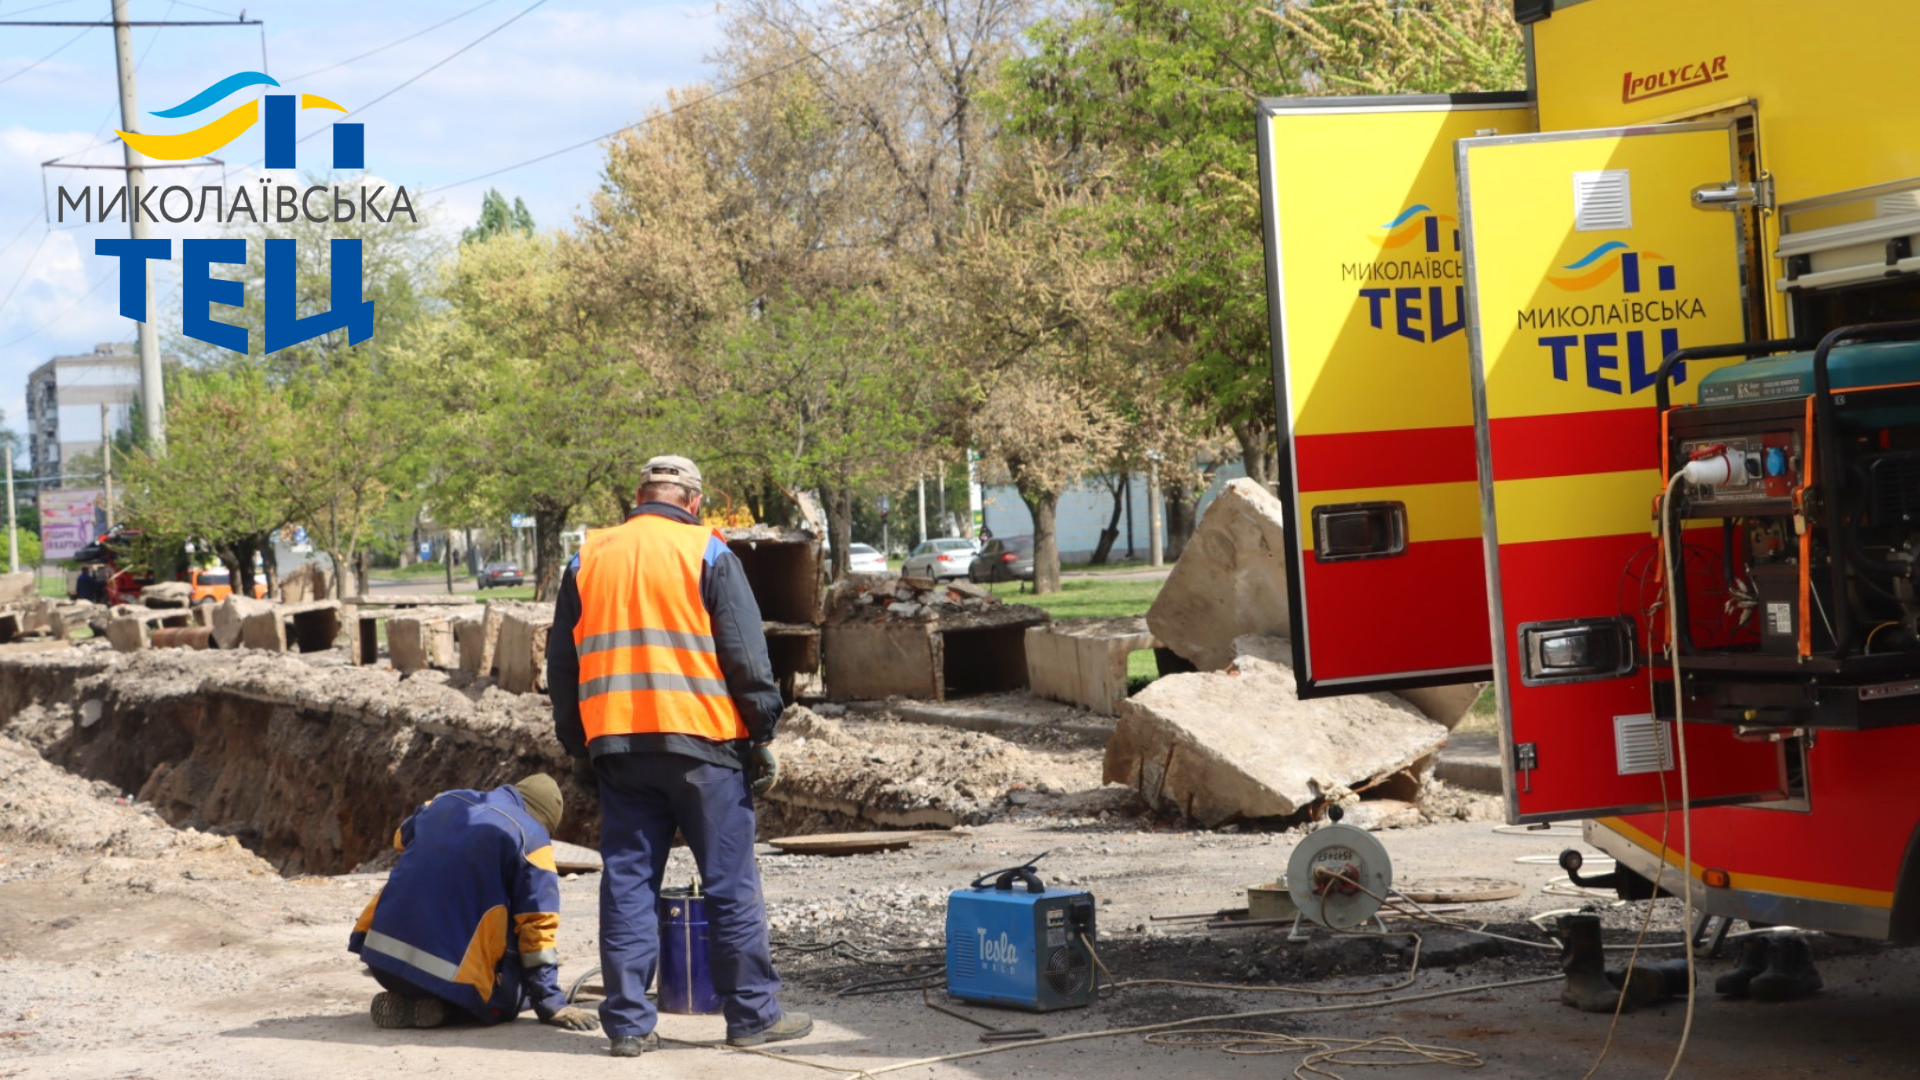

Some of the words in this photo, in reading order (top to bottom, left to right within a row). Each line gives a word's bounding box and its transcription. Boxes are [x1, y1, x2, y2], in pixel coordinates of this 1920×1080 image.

[1622, 55, 1728, 104] POLYCAR
[1518, 298, 1706, 330] МИКОЛАЇВСЬКА
[1538, 328, 1687, 395] ТЕЦ
[977, 927, 1019, 964] Tesla
